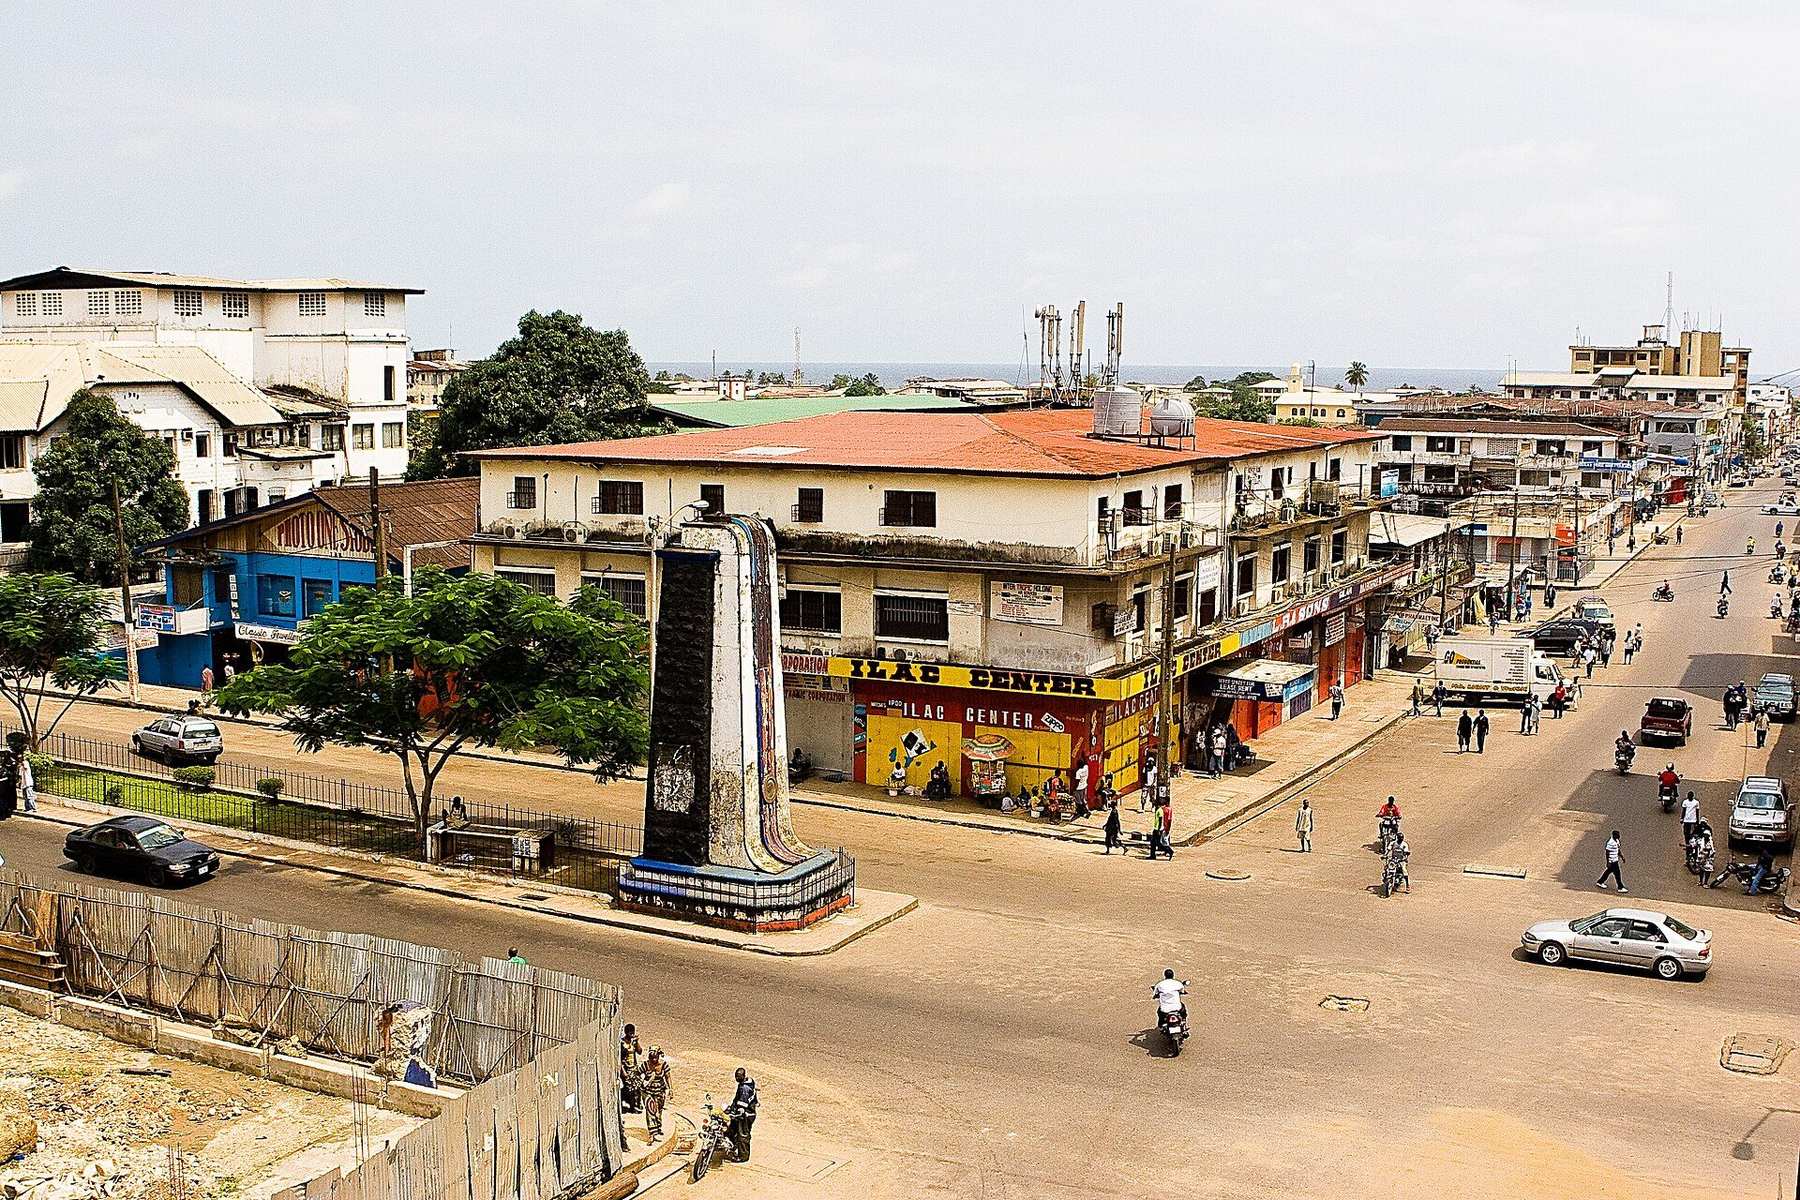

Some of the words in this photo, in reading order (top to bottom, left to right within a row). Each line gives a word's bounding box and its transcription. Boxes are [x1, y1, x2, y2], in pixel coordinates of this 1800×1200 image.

[276, 512, 315, 549] PHOTO
[782, 655, 829, 674] RPORATION
[850, 659, 940, 683] ILAC
[969, 669, 1097, 697] CENTER
[903, 702, 944, 720] ILAC
[966, 707, 1033, 729] CENTER
